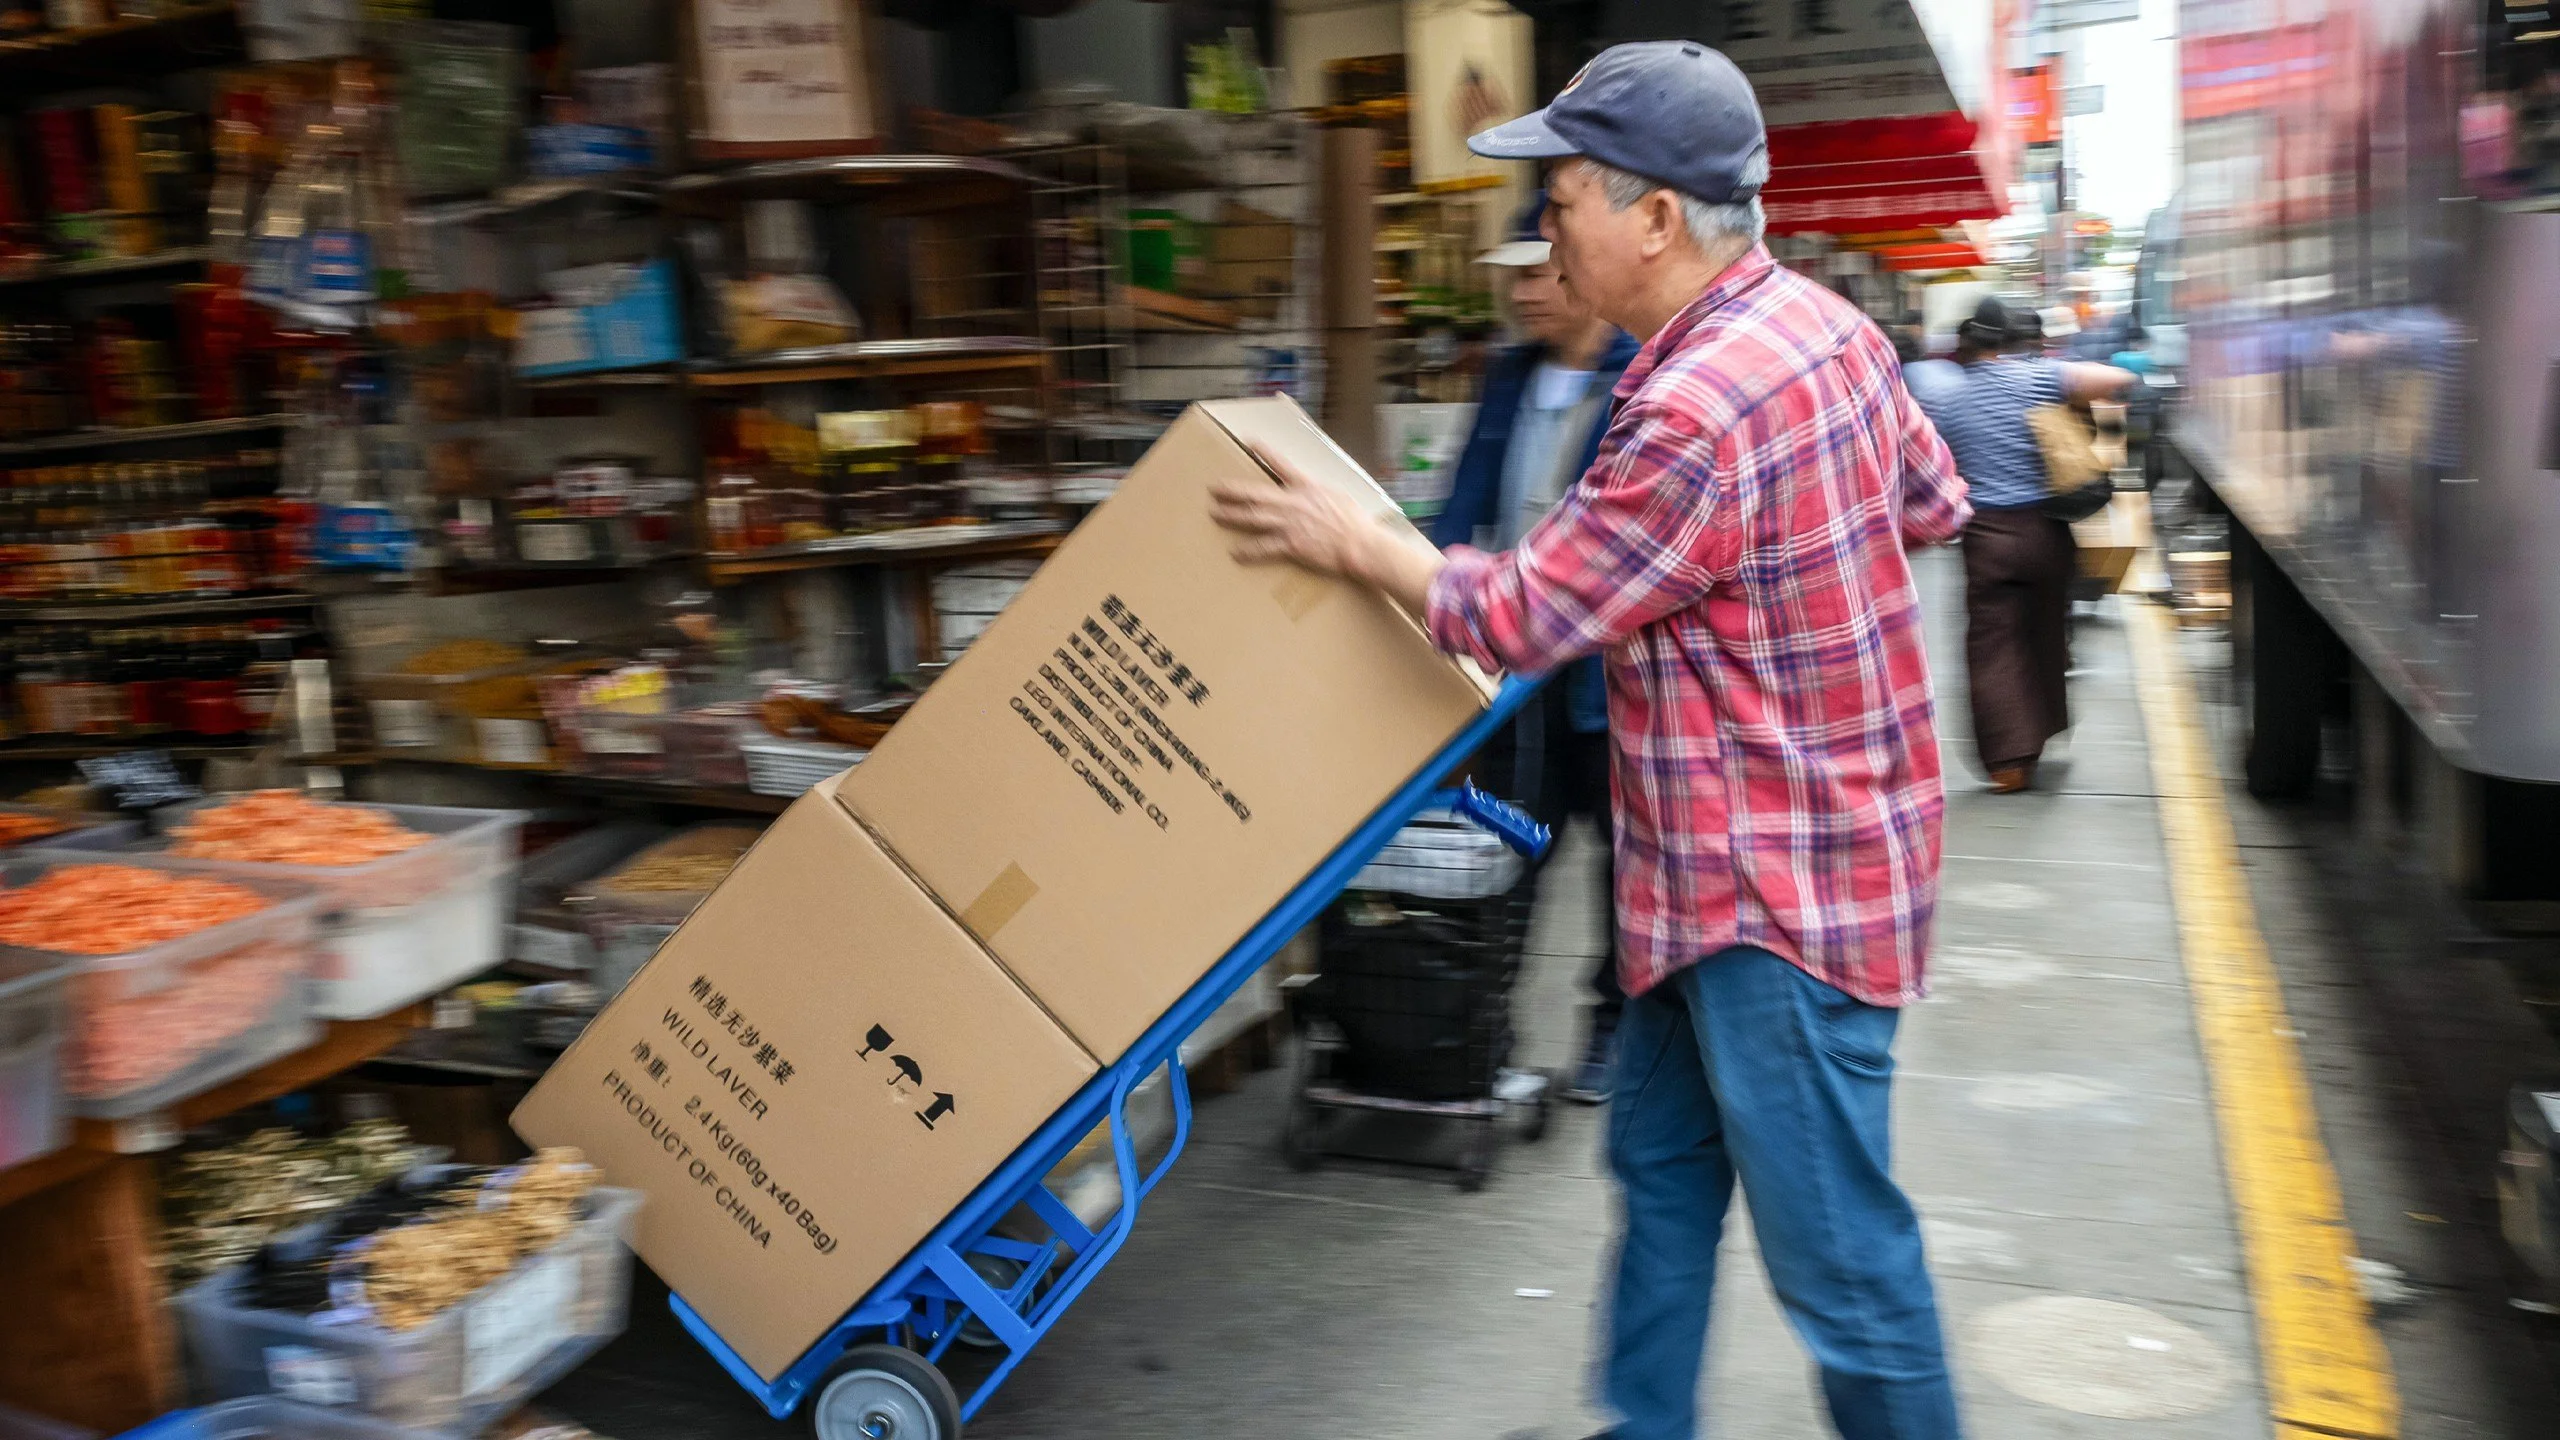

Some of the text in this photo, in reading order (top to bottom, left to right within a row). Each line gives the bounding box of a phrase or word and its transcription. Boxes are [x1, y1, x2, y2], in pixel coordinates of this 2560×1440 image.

[1038, 663, 1125, 751] DISTRIBUTED
[1053, 647, 1174, 774] PRODUCT OF CHINA
[1081, 614, 1170, 710] WILD LAVER
[1023, 679, 1054, 710] LEO
[1049, 705, 1147, 810] INTERNATIONAL
[662, 1007, 768, 1121] WILD LAVER
[689, 975, 795, 1086] 精选无沙紫菜
[603, 1069, 771, 1249] PRODUCT OF CHINA
